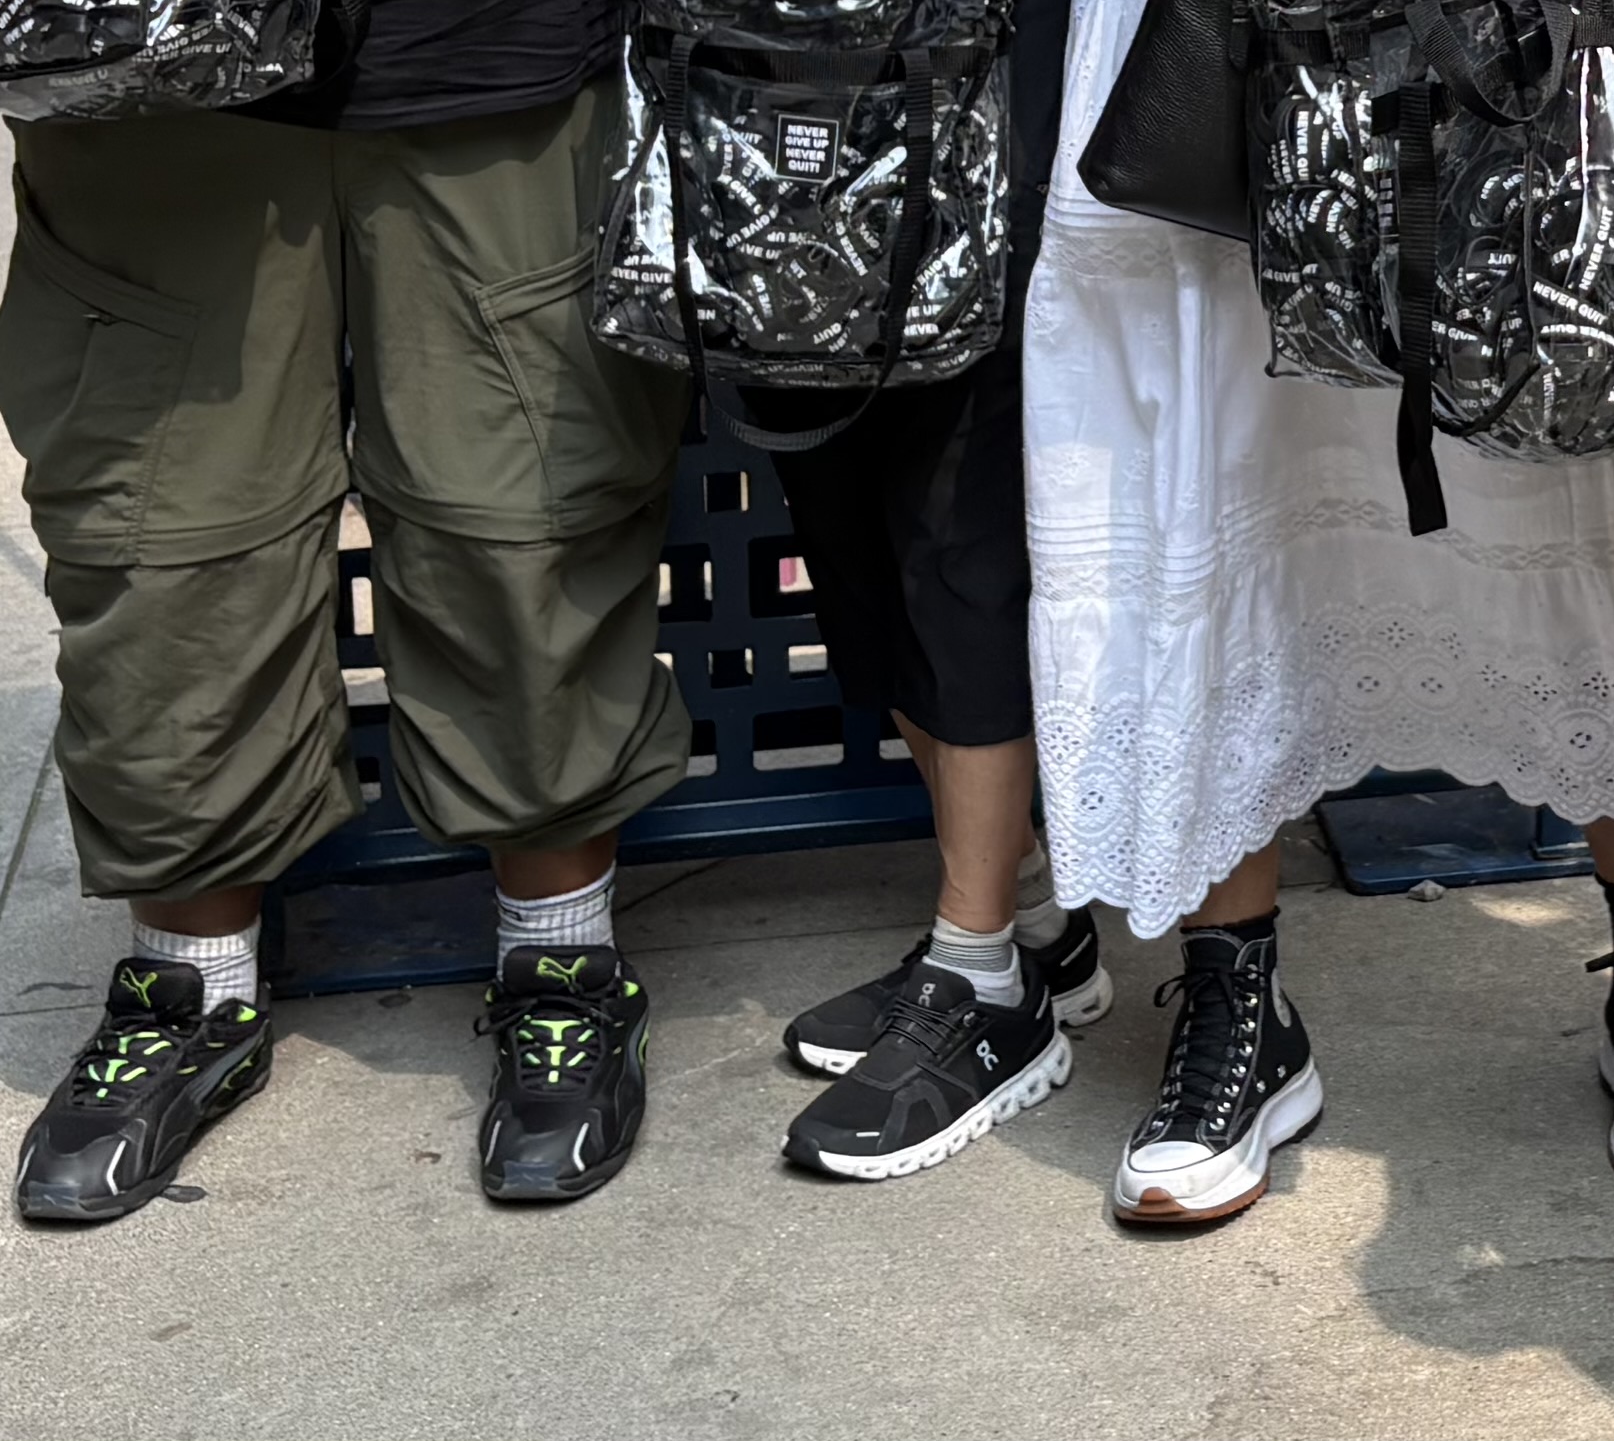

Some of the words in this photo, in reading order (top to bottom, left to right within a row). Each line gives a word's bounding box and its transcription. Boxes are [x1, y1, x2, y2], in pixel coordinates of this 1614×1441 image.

[787, 125, 829, 138] NEVER
[1296, 111, 1309, 154] NEVER
[785, 136, 811, 147] GIVE
[813, 138, 829, 149] UP
[785, 148, 826, 162] NEVER
[1578, 242, 1605, 291] NEVER
[1597, 205, 1614, 242] QUIT
[641, 272, 672, 284] GIVE
[1533, 281, 1579, 311] NEVER
[1578, 303, 1609, 325] QUIT
[813, 322, 842, 345] QUIT
